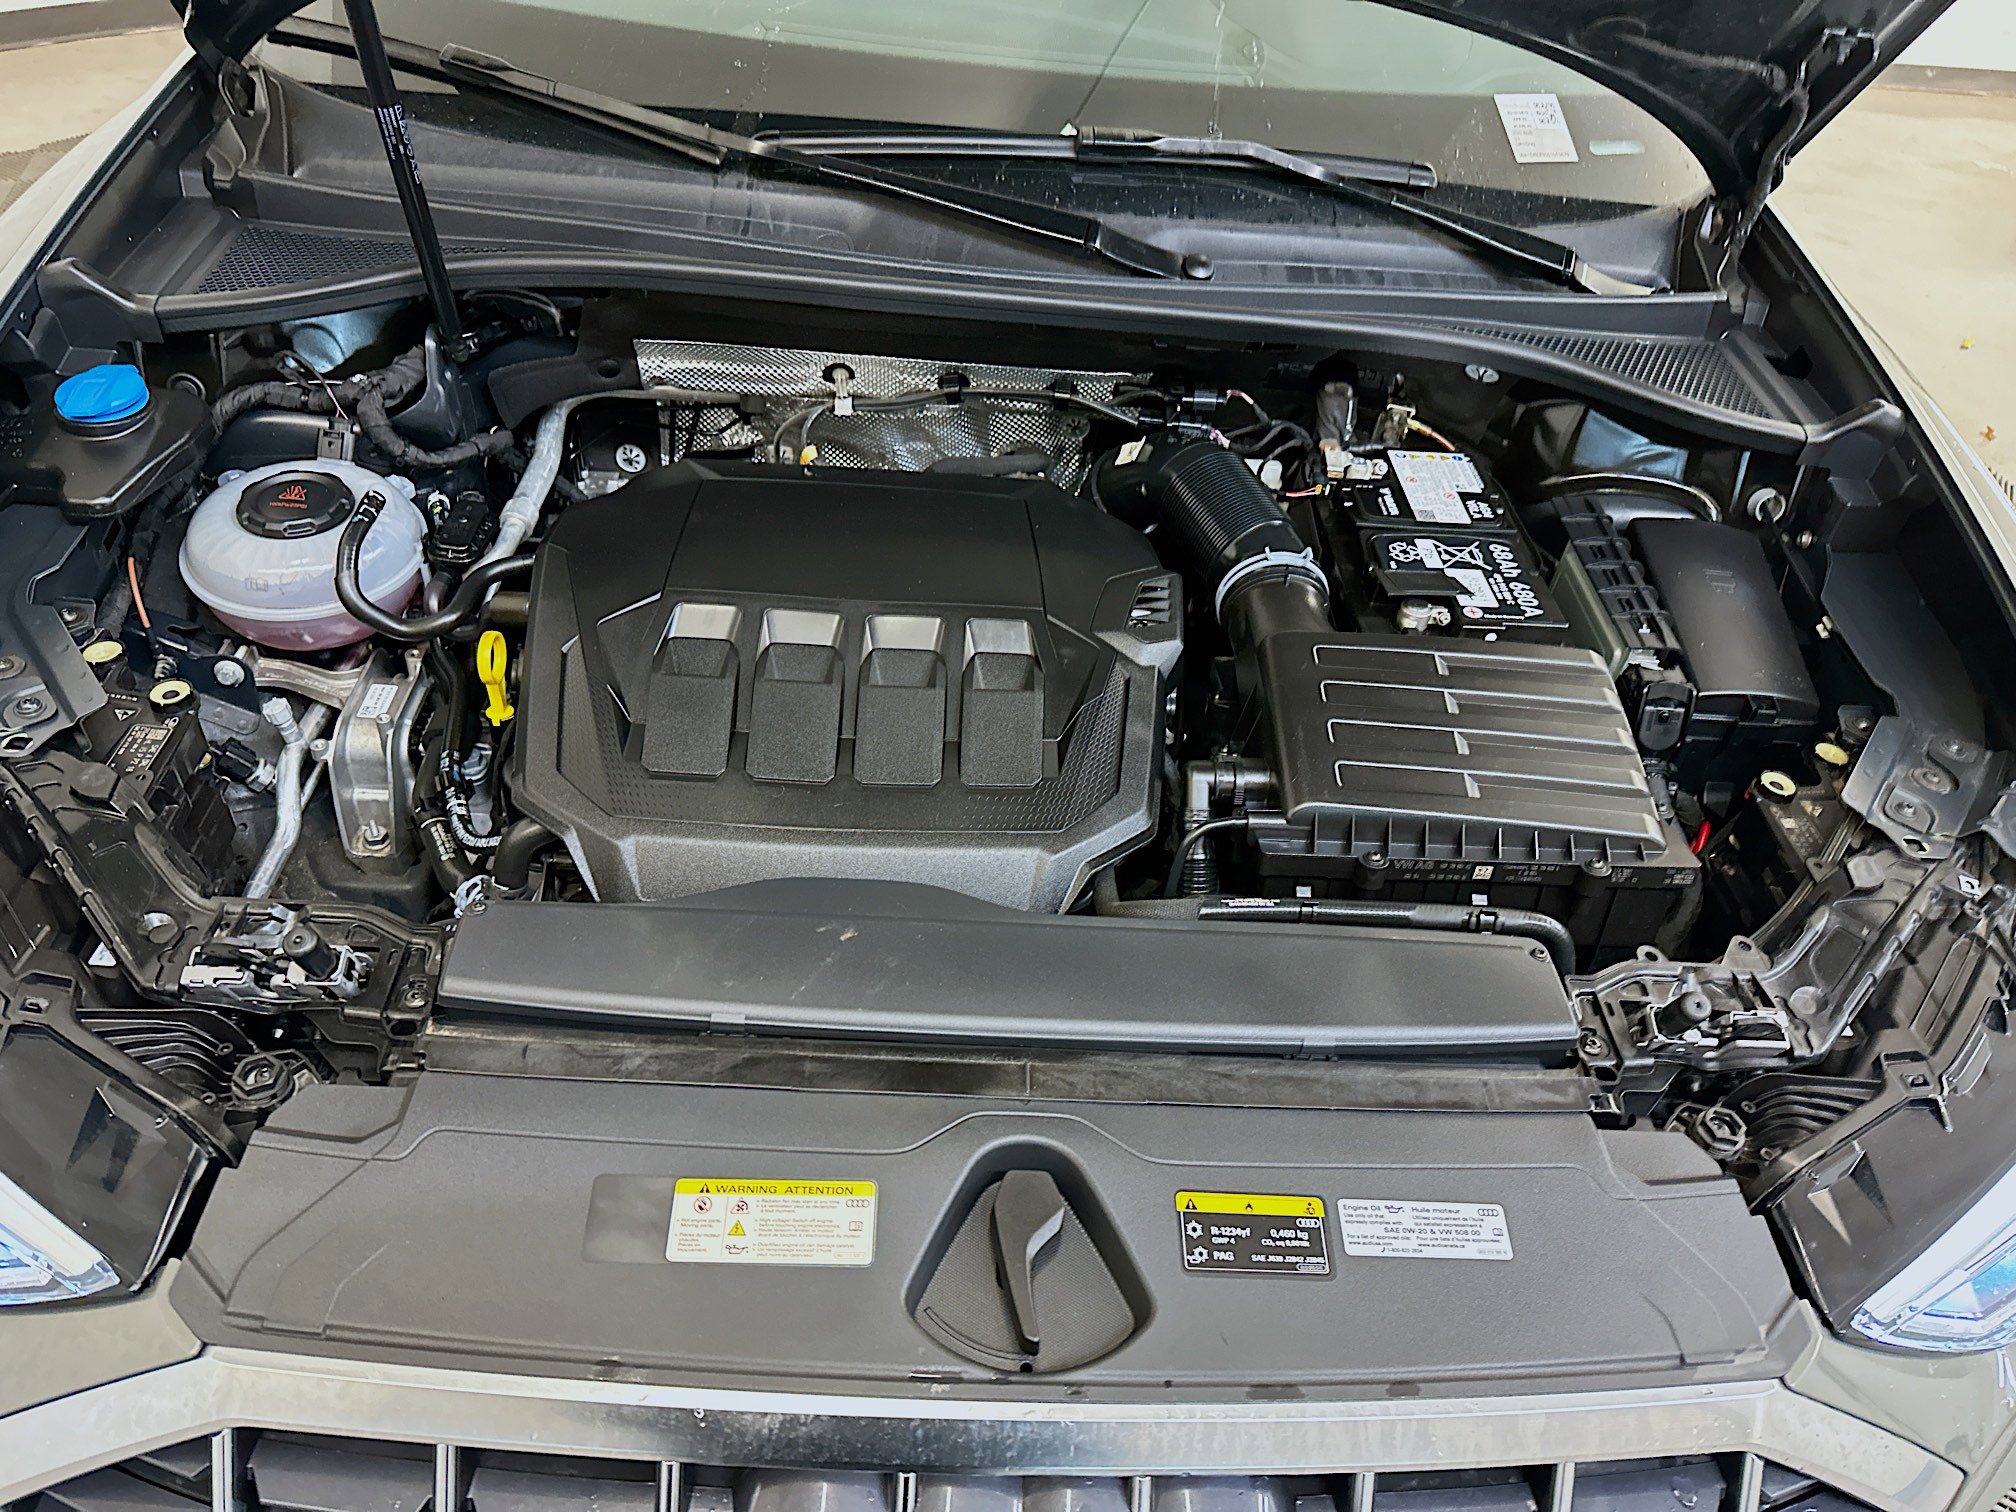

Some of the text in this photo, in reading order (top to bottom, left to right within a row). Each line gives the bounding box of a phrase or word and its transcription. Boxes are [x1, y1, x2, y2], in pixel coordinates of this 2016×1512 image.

[1488, 543, 1522, 578] 68Ah
[1508, 581, 1544, 617] 680A
[715, 1185, 854, 1195] WARNING ATTENTION
[1210, 1226, 1309, 1240] R-1234yf 0,460 kg
[1213, 1250, 1235, 1260] PAG
[1251, 1254, 1266, 1262] SAE
